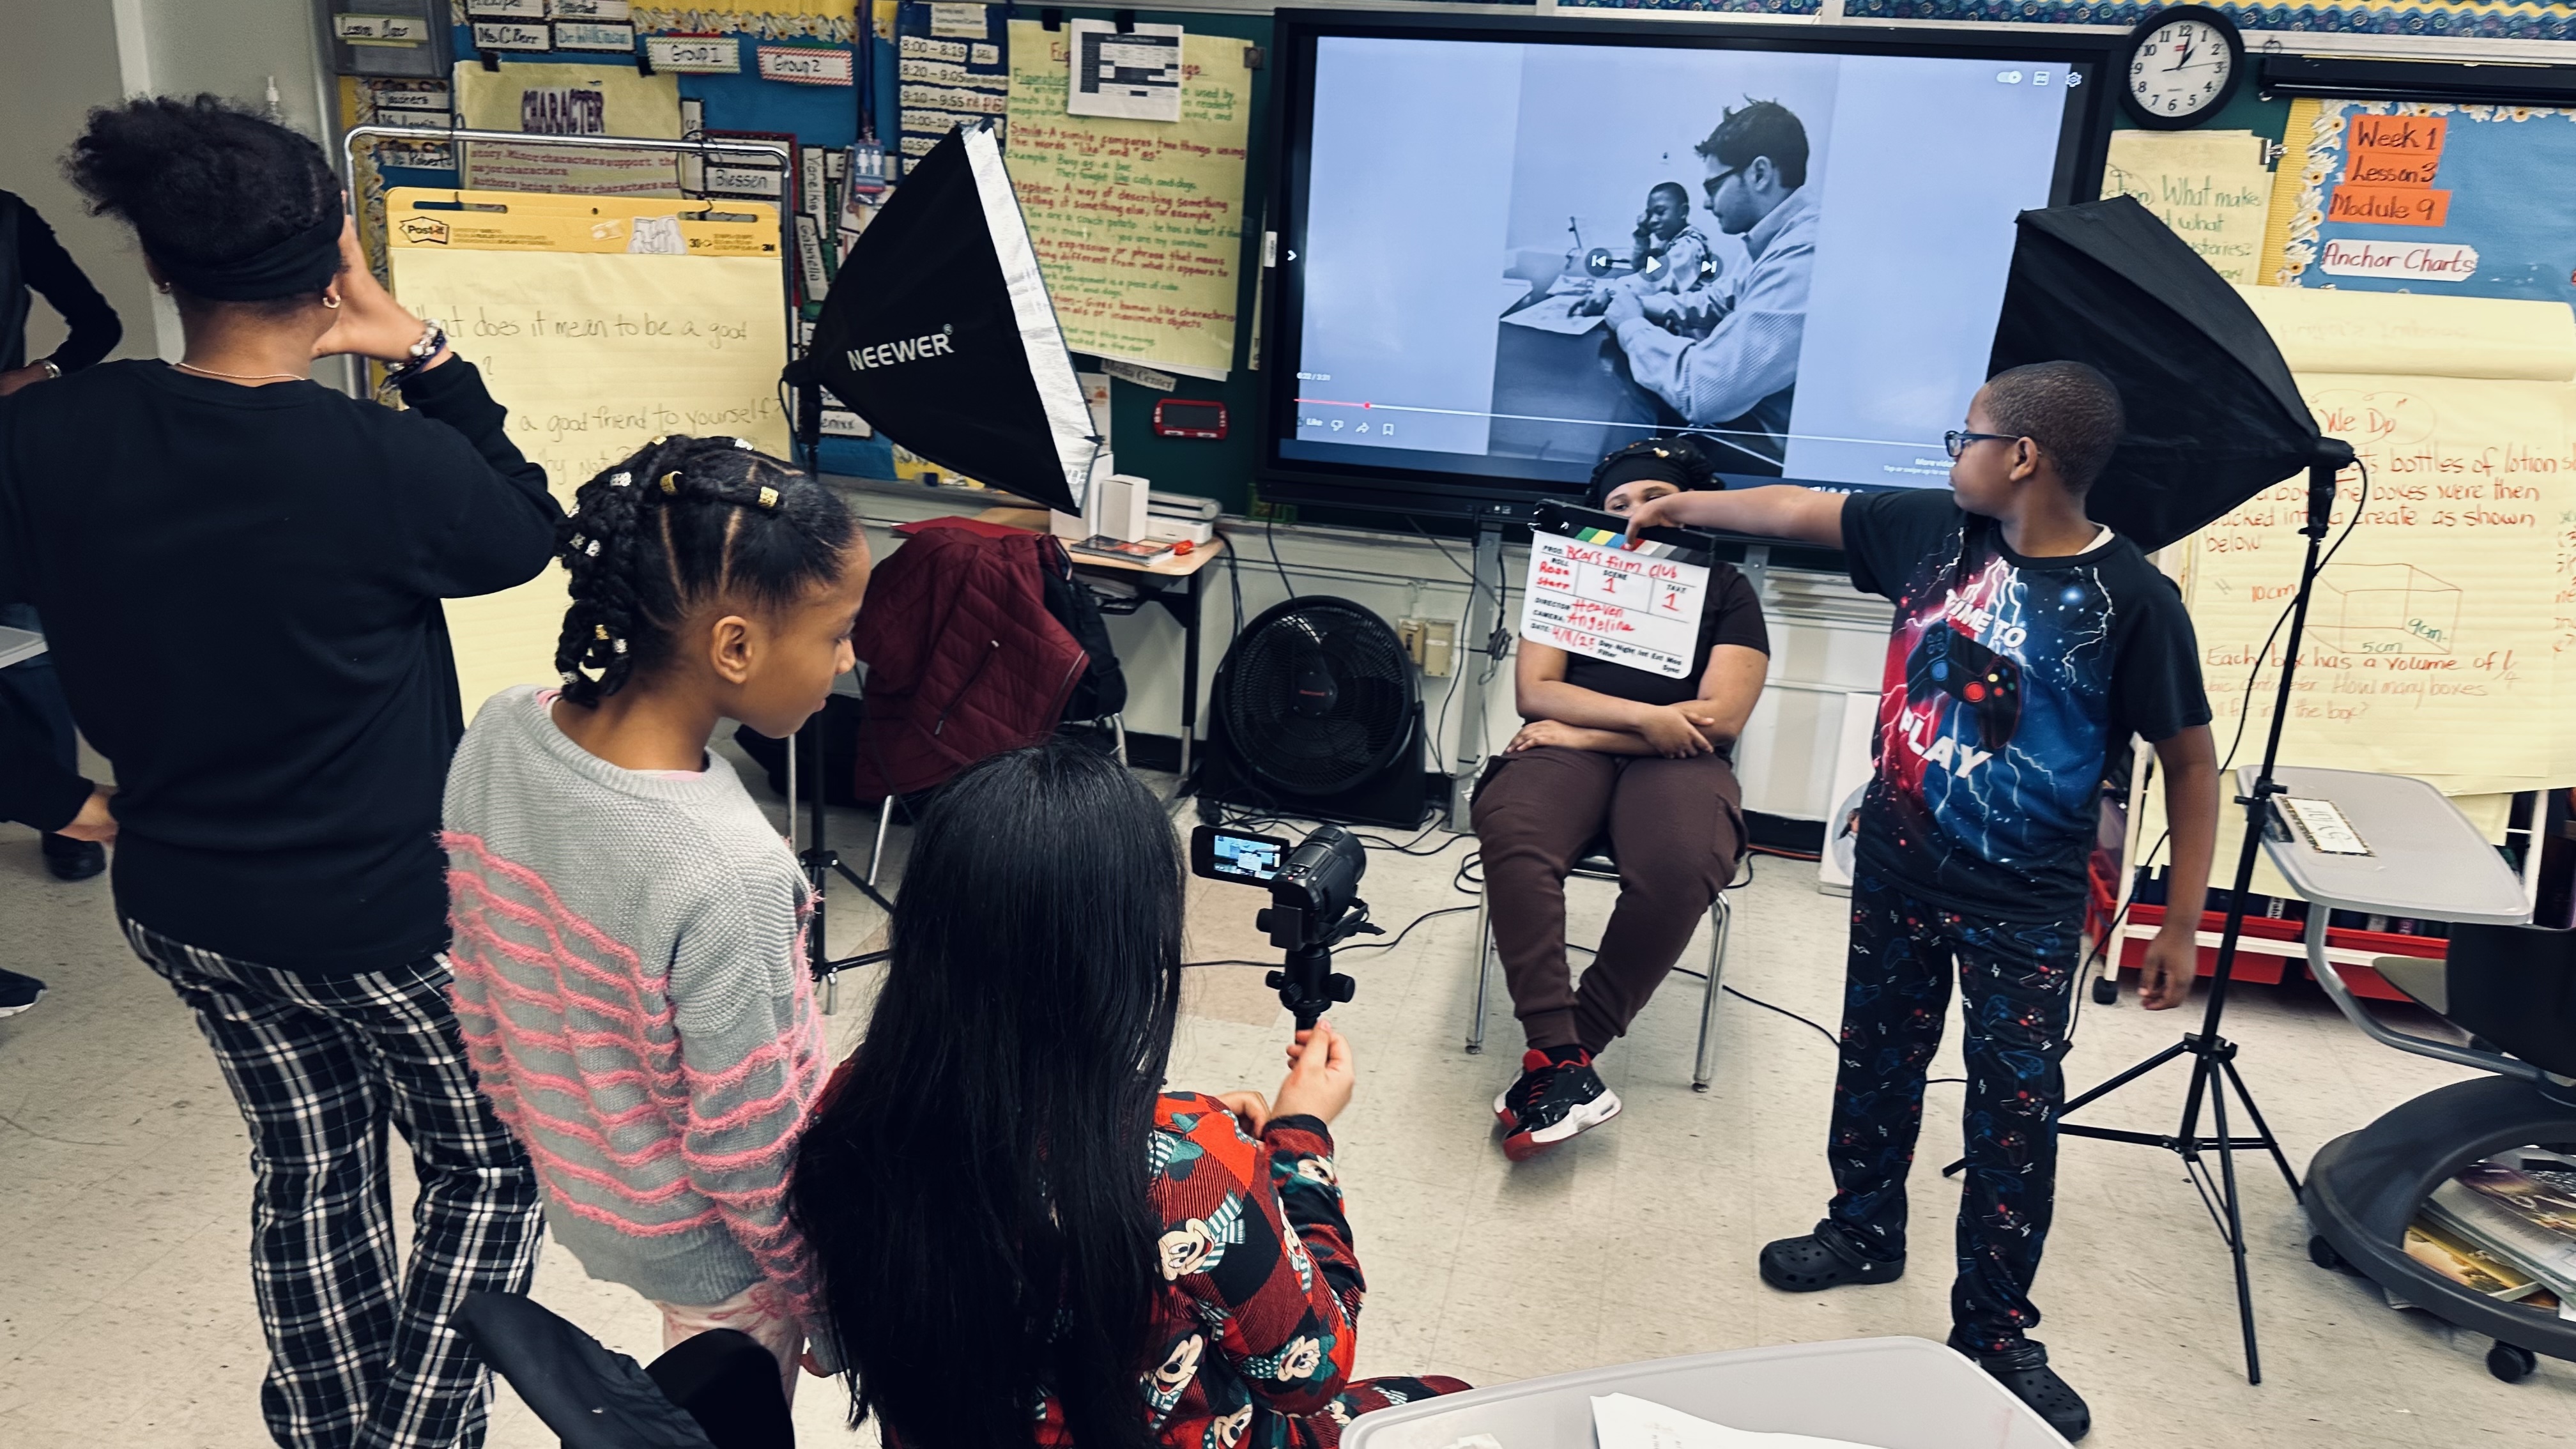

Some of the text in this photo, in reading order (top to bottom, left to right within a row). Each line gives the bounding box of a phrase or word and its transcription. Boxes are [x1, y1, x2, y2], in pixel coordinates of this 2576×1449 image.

[2159, 30, 2208, 42] 11 1
[2179, 25, 2193, 37] 12
[671, 45, 709, 62] Group
[903, 40, 927, 53] 8:00
[2143, 43, 2221, 56] 10 2
[774, 55, 822, 75] Group 2
[903, 64, 927, 77] 8:20
[940, 70, 965, 82] 9:05
[2134, 61, 2223, 74] 9 3
[2138, 81, 2212, 92] 8 4
[903, 91, 927, 103] 9:10
[940, 95, 964, 107] 9:55
[2150, 95, 2196, 111] 7 6 5
[521, 88, 602, 134] CHARACTER
[2356, 121, 2437, 151] Week 1
[2351, 155, 2439, 183] Lesson 3
[2162, 174, 2212, 206] What
[2328, 192, 2435, 222] Module 9
[407, 226, 445, 236] Post-it
[2178, 213, 2225, 233] what
[2322, 242, 2475, 273] Anchor Charts
[473, 306, 521, 337] does
[532, 310, 546, 337] it
[555, 319, 608, 338] mean
[615, 313, 640, 337] to
[645, 312, 673, 337] be
[681, 320, 702, 337] a
[709, 320, 748, 349] good
[521, 415, 538, 431] a
[547, 412, 588, 443] good
[592, 405, 647, 433] friend
[652, 403, 678, 434] to
[2320, 407, 2398, 434] We Do
[2390, 441, 2465, 473] bottles
[2472, 447, 2499, 477] of
[2504, 442, 2557, 473] lotion
[2373, 477, 2540, 502] boxes were then
[2432, 510, 2457, 526] as
[2464, 503, 2535, 528] shown
[2204, 529, 2262, 553] below
[1551, 557, 1569, 567] ROLL
[1604, 570, 1628, 580] SCENE
[1601, 577, 1616, 593] 1
[1667, 584, 1687, 594] TAKE
[2251, 584, 2296, 602] 10cm
[1572, 599, 1624, 618] Heaven
[1662, 593, 1680, 611] 1
[1945, 588, 2027, 648] TIME TO
[2362, 641, 2404, 654] 5cm
[2206, 644, 2257, 666] Each
[2314, 646, 2352, 670] has
[2363, 658, 2377, 668] a
[2384, 657, 2462, 671] volume
[2472, 651, 2499, 671] of
[2380, 681, 2425, 710] many
[2430, 673, 2488, 696] boxes
[1898, 705, 1994, 779] PLAY
